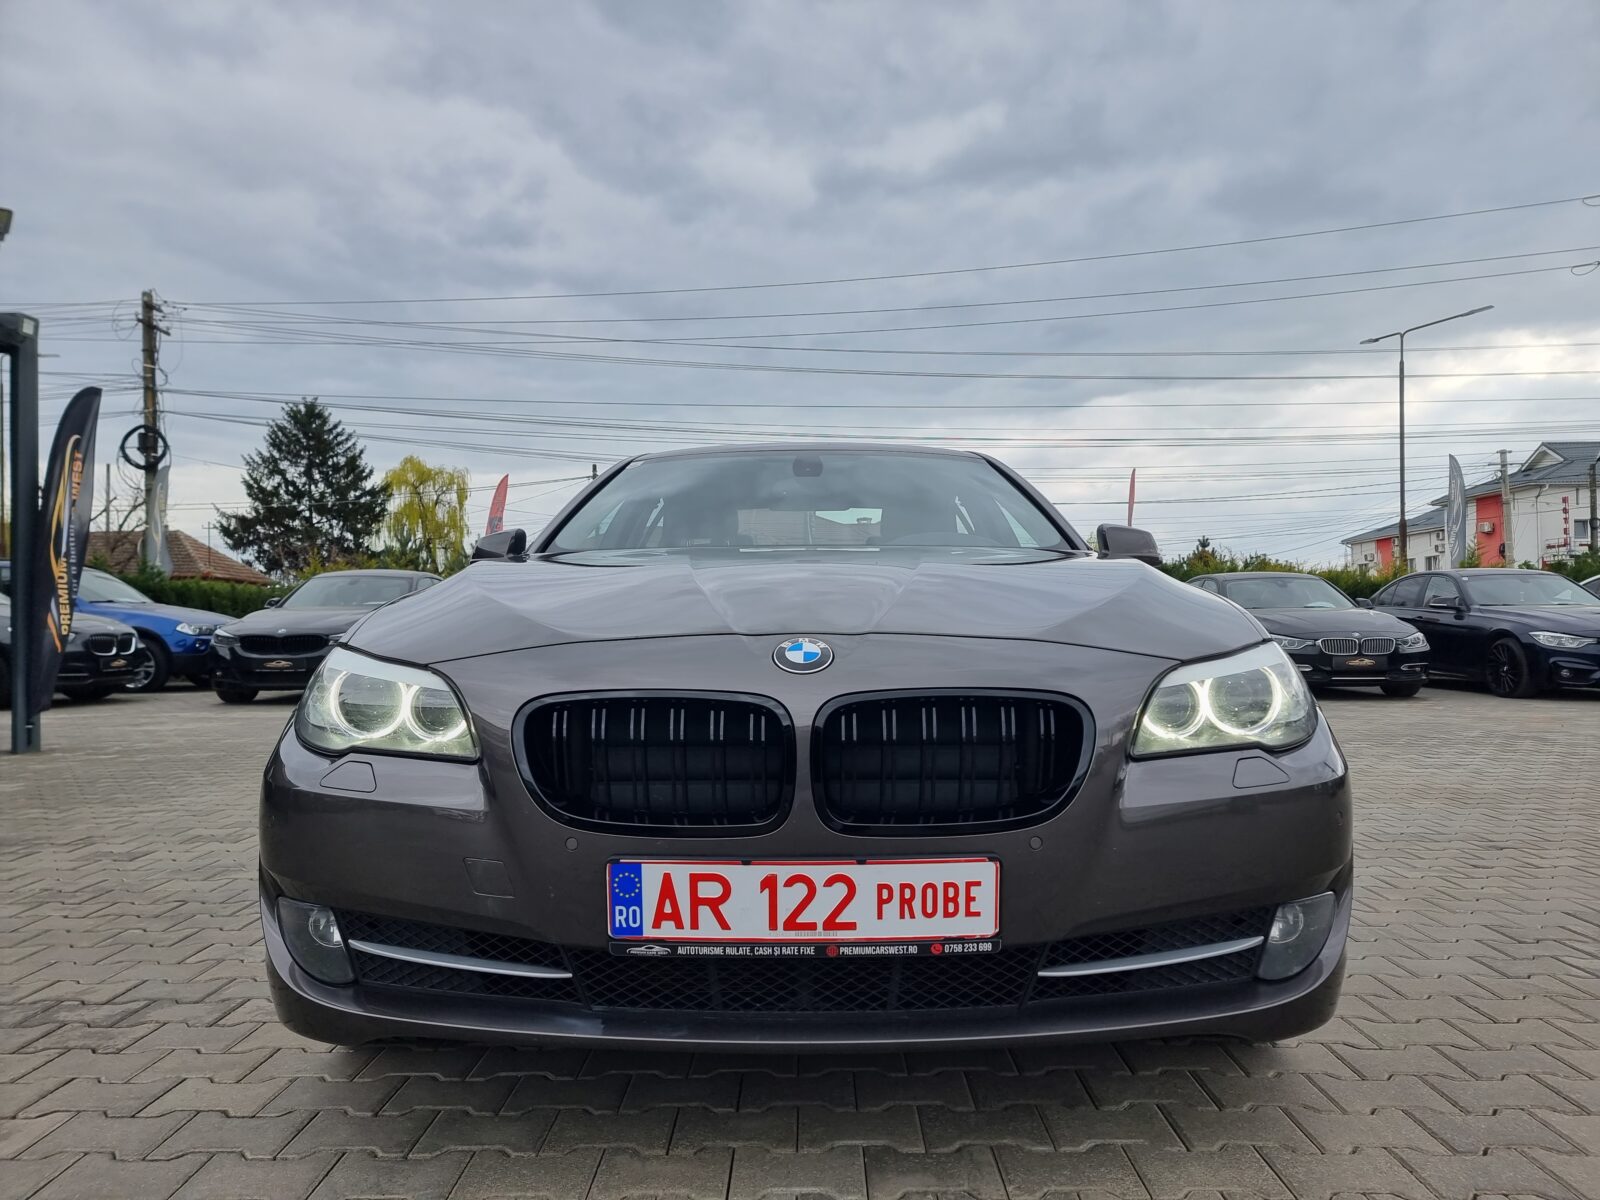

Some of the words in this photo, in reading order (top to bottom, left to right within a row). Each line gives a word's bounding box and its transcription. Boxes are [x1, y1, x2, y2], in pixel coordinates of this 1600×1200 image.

[71, 449, 83, 500] WEST
[652, 872, 732, 930] AR
[760, 873, 857, 931] 122
[876, 881, 982, 920] PROBE
[615, 905, 641, 928] RO
[677, 946, 724, 955] AUTOTURISME
[725, 946, 753, 956] RULATE,
[754, 946, 772, 955] CASH
[781, 946, 799, 955] RATE
[800, 946, 815, 955] FIXE
[839, 945, 918, 955] PREMIUMCARSWEST.RO
[944, 944, 963, 953] 0758
[964, 943, 978, 952] 233
